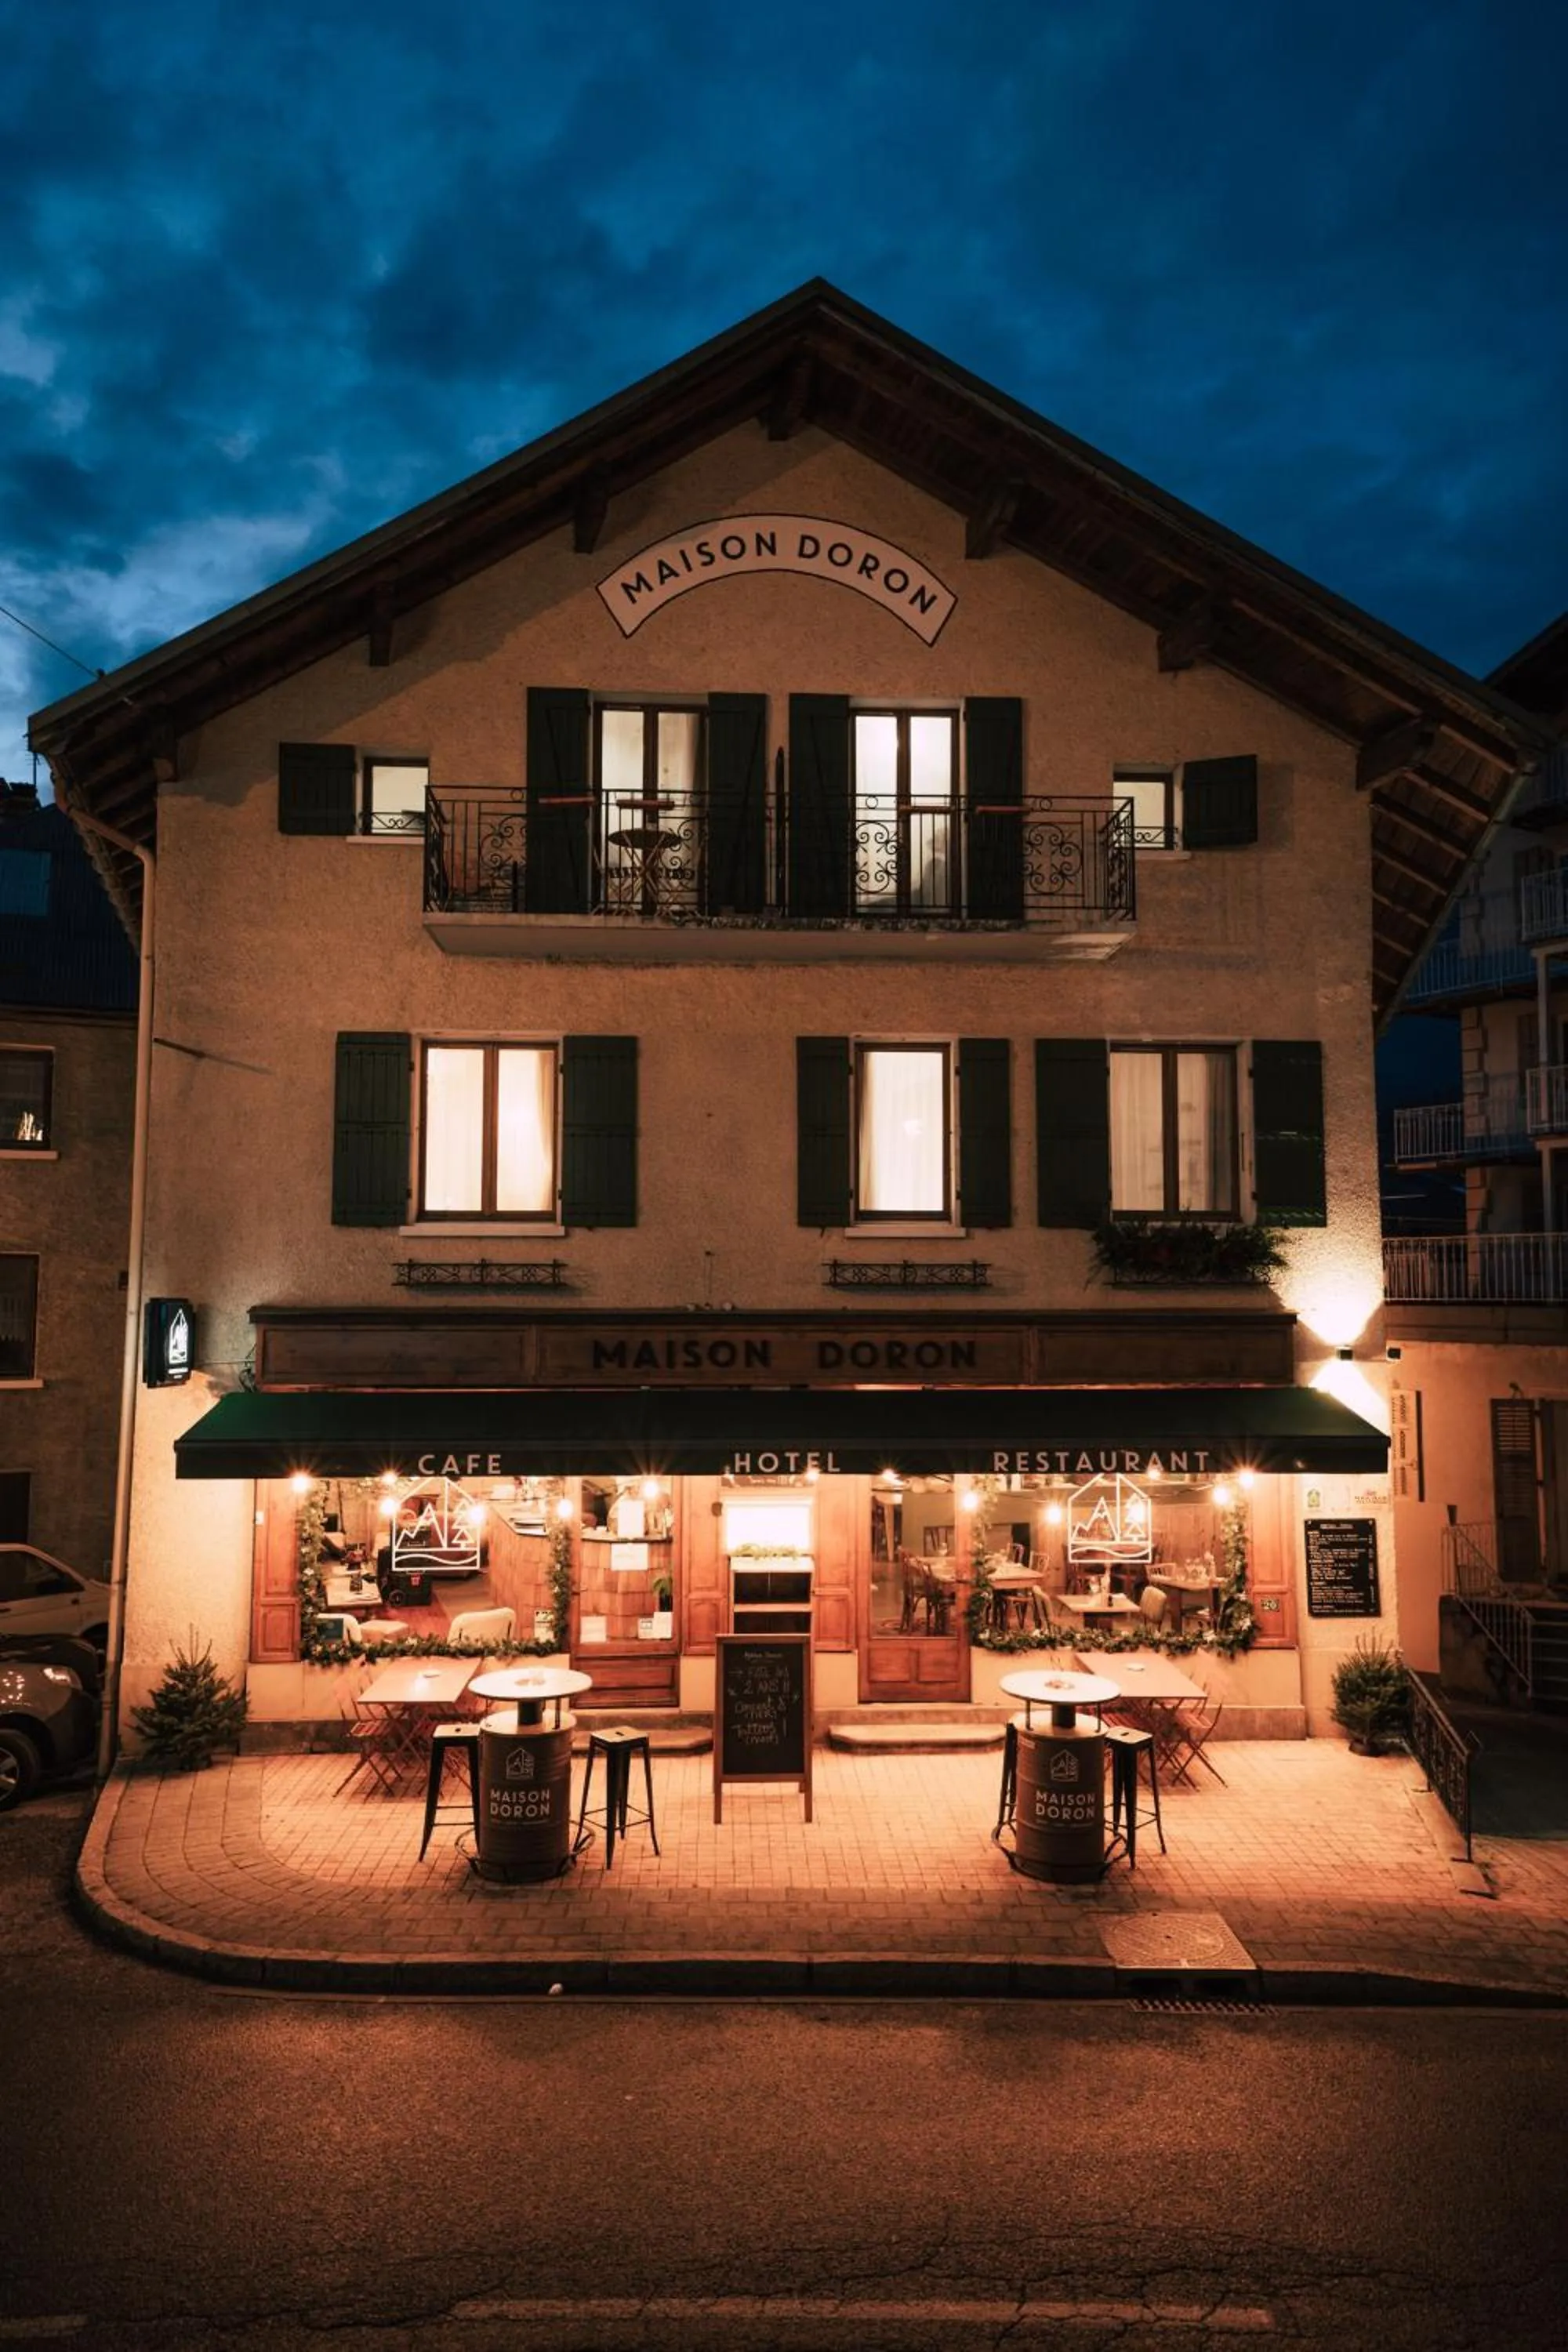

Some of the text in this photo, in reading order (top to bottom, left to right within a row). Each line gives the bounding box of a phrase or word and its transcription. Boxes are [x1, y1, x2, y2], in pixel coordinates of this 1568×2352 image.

[620, 532, 938, 614] MAISON DORON
[593, 1339, 977, 1370] MAISON DORON
[418, 1454, 501, 1475] CAFE
[735, 1452, 840, 1473] HOTEL
[993, 1451, 1209, 1472] RESTAURANT
[490, 1788, 550, 1803] MAISON
[1035, 1790, 1096, 1806] MAISON
[490, 1802, 550, 1818] DORON
[1035, 1803, 1096, 1820] DORON
